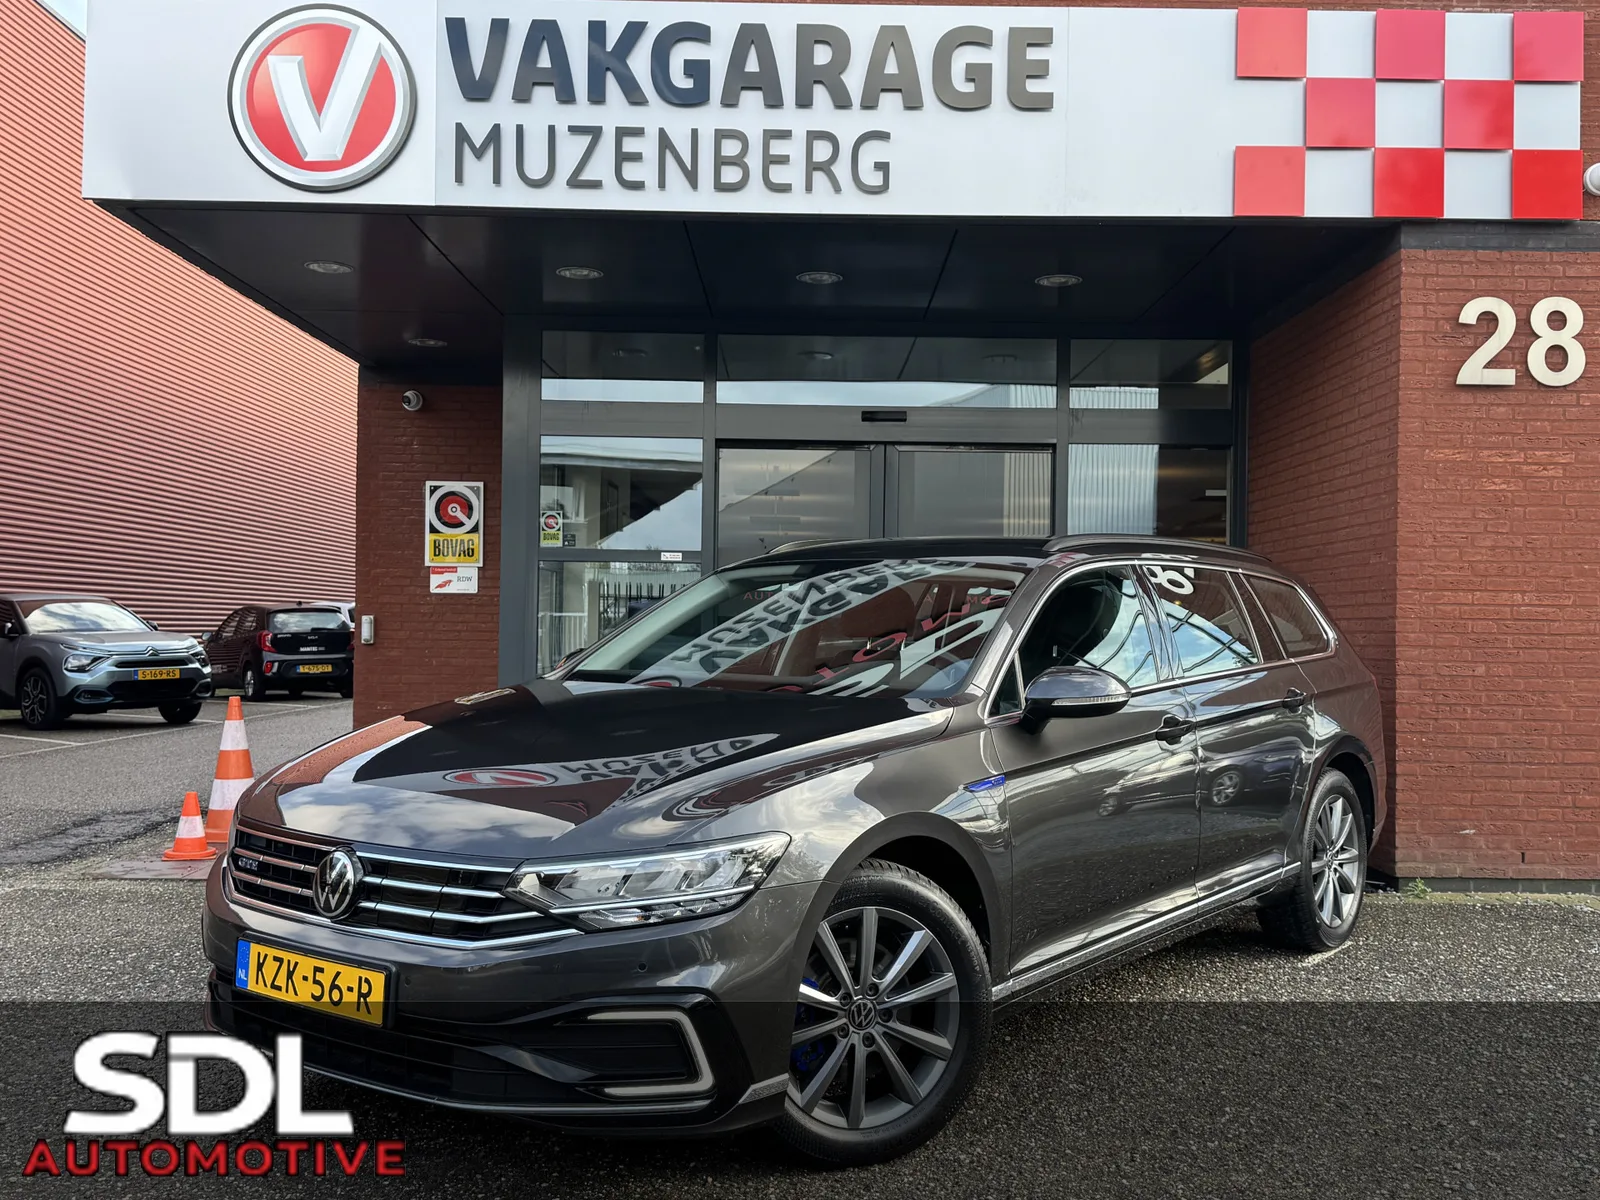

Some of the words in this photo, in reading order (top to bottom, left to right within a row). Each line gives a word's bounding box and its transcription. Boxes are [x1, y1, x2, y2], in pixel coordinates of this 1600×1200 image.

[445, 17, 1054, 111] VAKGARAGE
[455, 122, 891, 195] MUZENBERG
[1456, 296, 1586, 387] 28
[433, 538, 475, 558] BOVAG
[141, 669, 177, 679] S-169-RS
[237, 967, 248, 981] NL
[255, 951, 373, 1015] KZK-56-R
